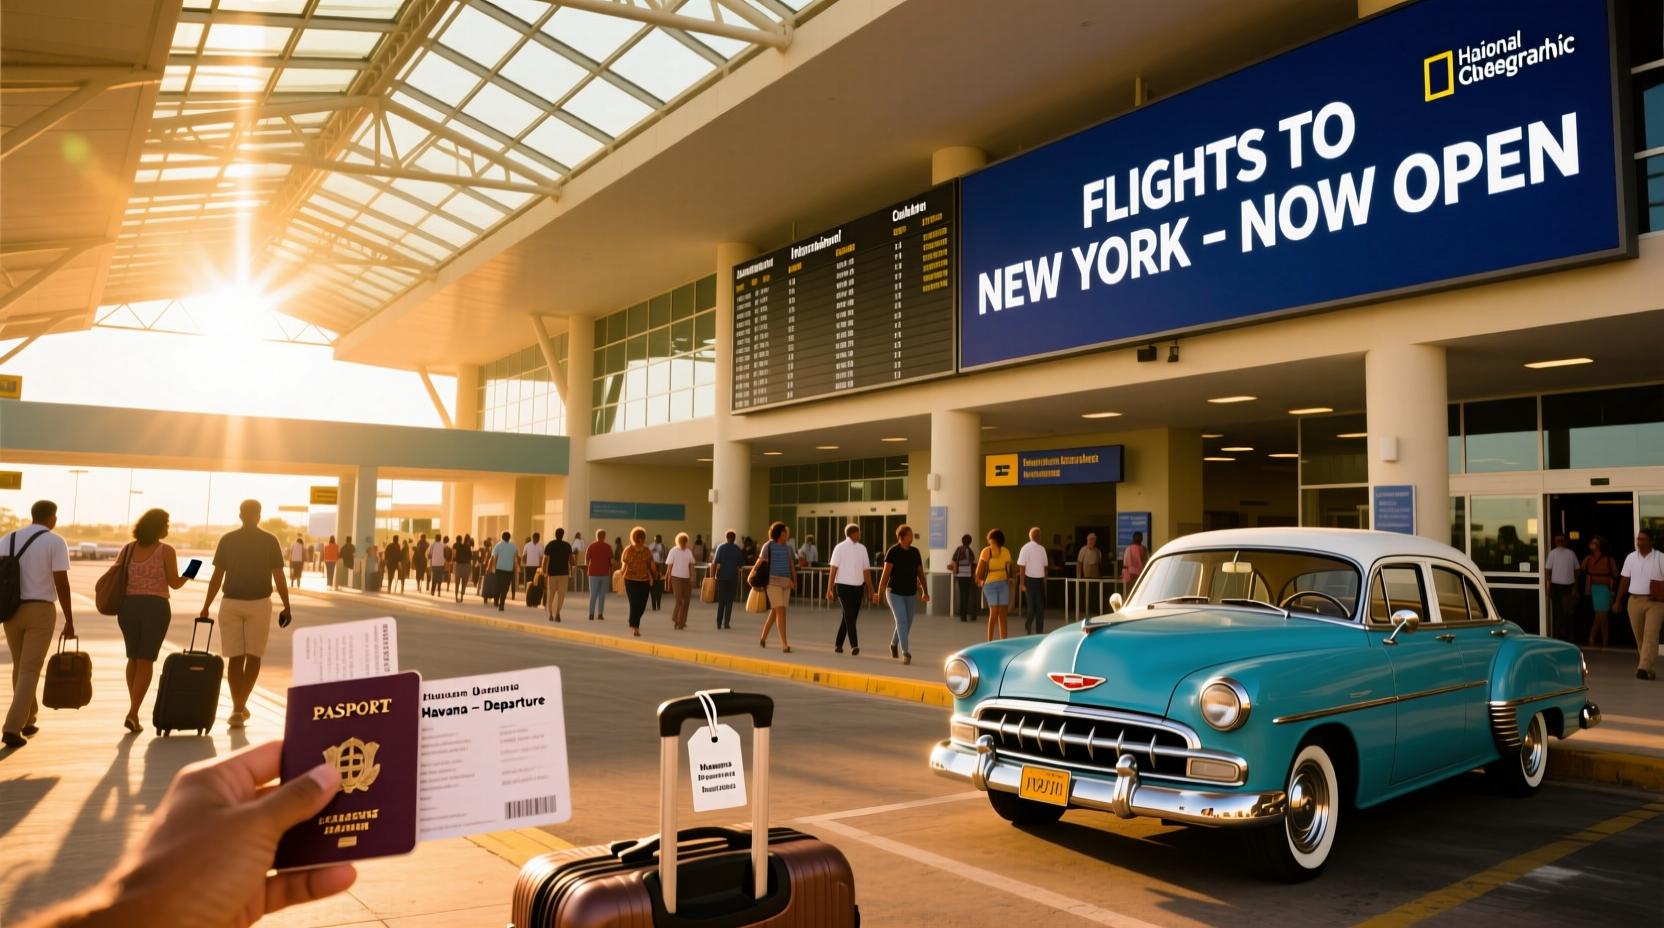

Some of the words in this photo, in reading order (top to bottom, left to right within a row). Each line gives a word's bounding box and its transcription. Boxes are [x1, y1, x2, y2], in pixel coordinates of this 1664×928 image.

[1083, 128, 1267, 229] FLIGHTS
[1278, 101, 1356, 169] TO
[978, 251, 1063, 316] NEW
[1071, 216, 1192, 291] YORK
[1240, 165, 1376, 253] NOW
[1393, 111, 1580, 213] OPEN
[312, 698, 392, 721] PASPORT
[421, 705, 468, 719] Havana
[484, 696, 546, 714] Departure
